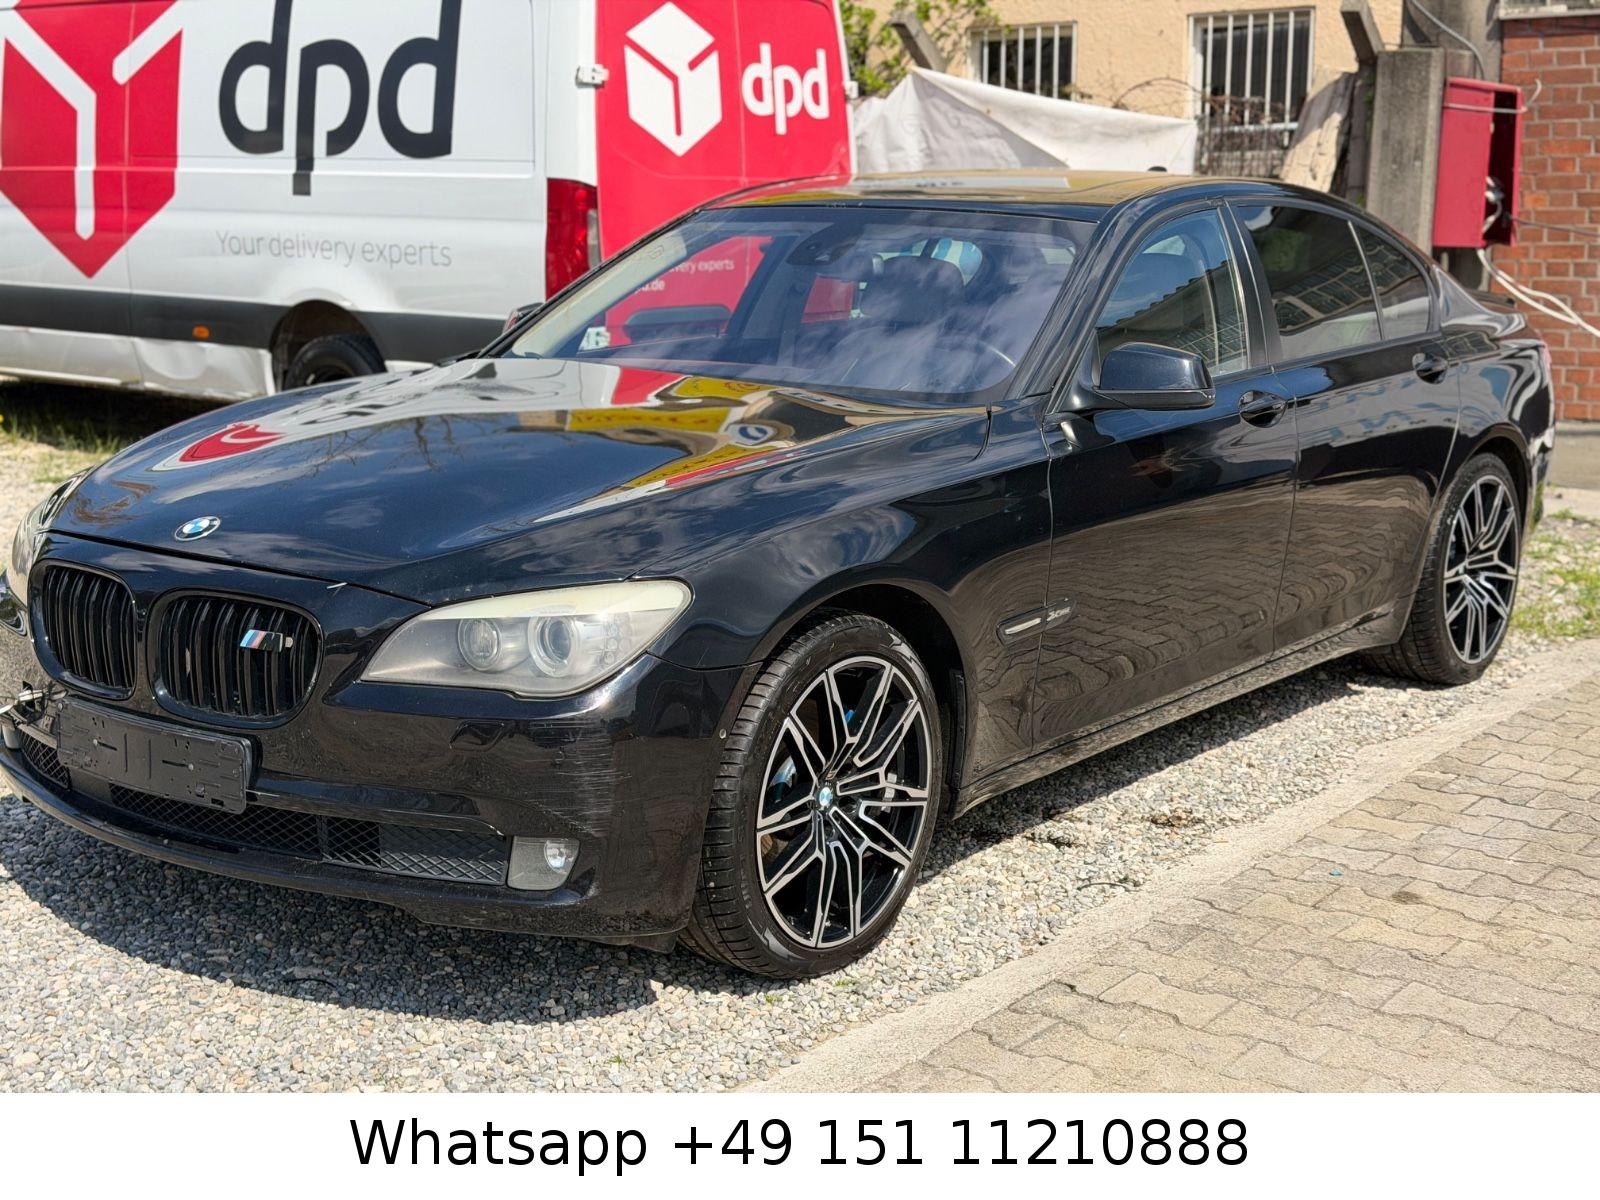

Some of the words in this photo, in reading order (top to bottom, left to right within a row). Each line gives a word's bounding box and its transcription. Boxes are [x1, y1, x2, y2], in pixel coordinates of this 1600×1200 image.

[219, 0, 462, 196] dpd
[741, 42, 829, 135] dpd
[216, 229, 264, 256] Your
[268, 233, 356, 268] delivery
[361, 240, 452, 270] experts
